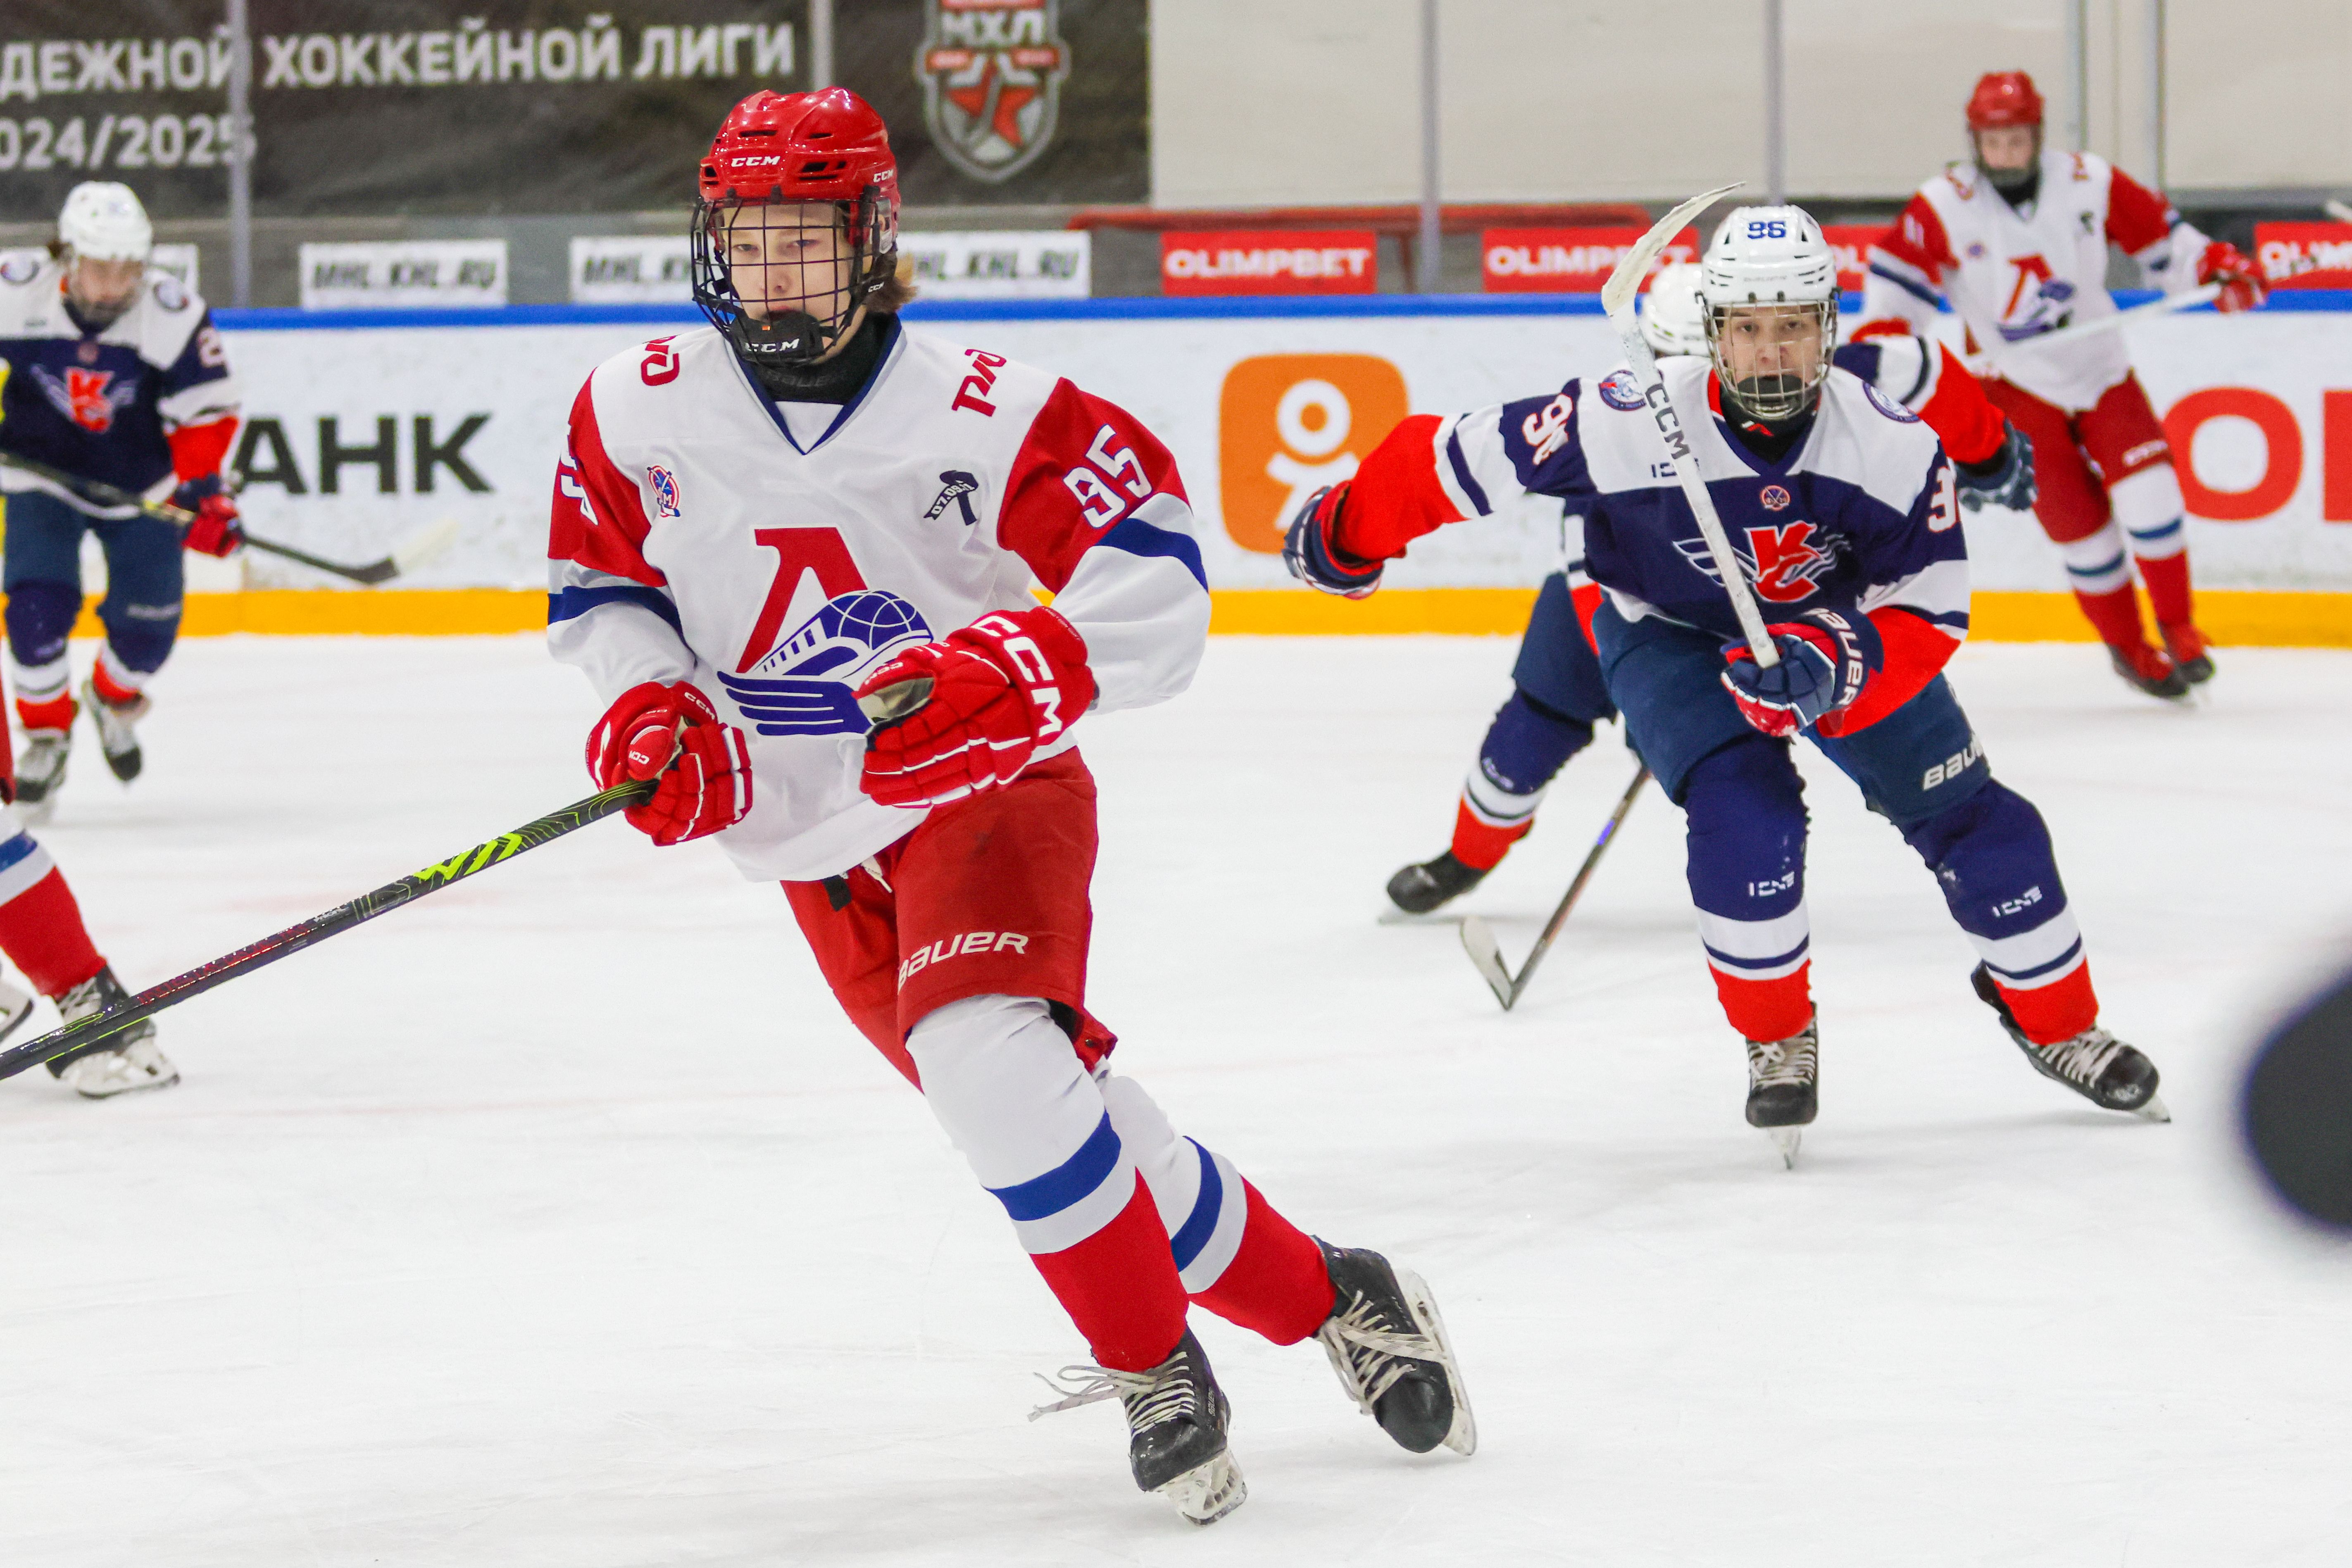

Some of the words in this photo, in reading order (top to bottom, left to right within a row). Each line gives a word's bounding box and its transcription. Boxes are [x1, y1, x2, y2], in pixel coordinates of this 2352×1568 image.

[262, 14, 623, 88] ХОККЕЙНОЙ
[633, 21, 796, 79] ЛИГИ
[941, 10, 1045, 45] МХЛ
[731, 156, 781, 167] CCM
[1747, 221, 1787, 239] 96
[1163, 249, 1371, 279] OLIMPBET
[1645, 383, 1691, 460] CCM
[1063, 423, 1154, 529] 95
[969, 615, 1063, 738] CCM
